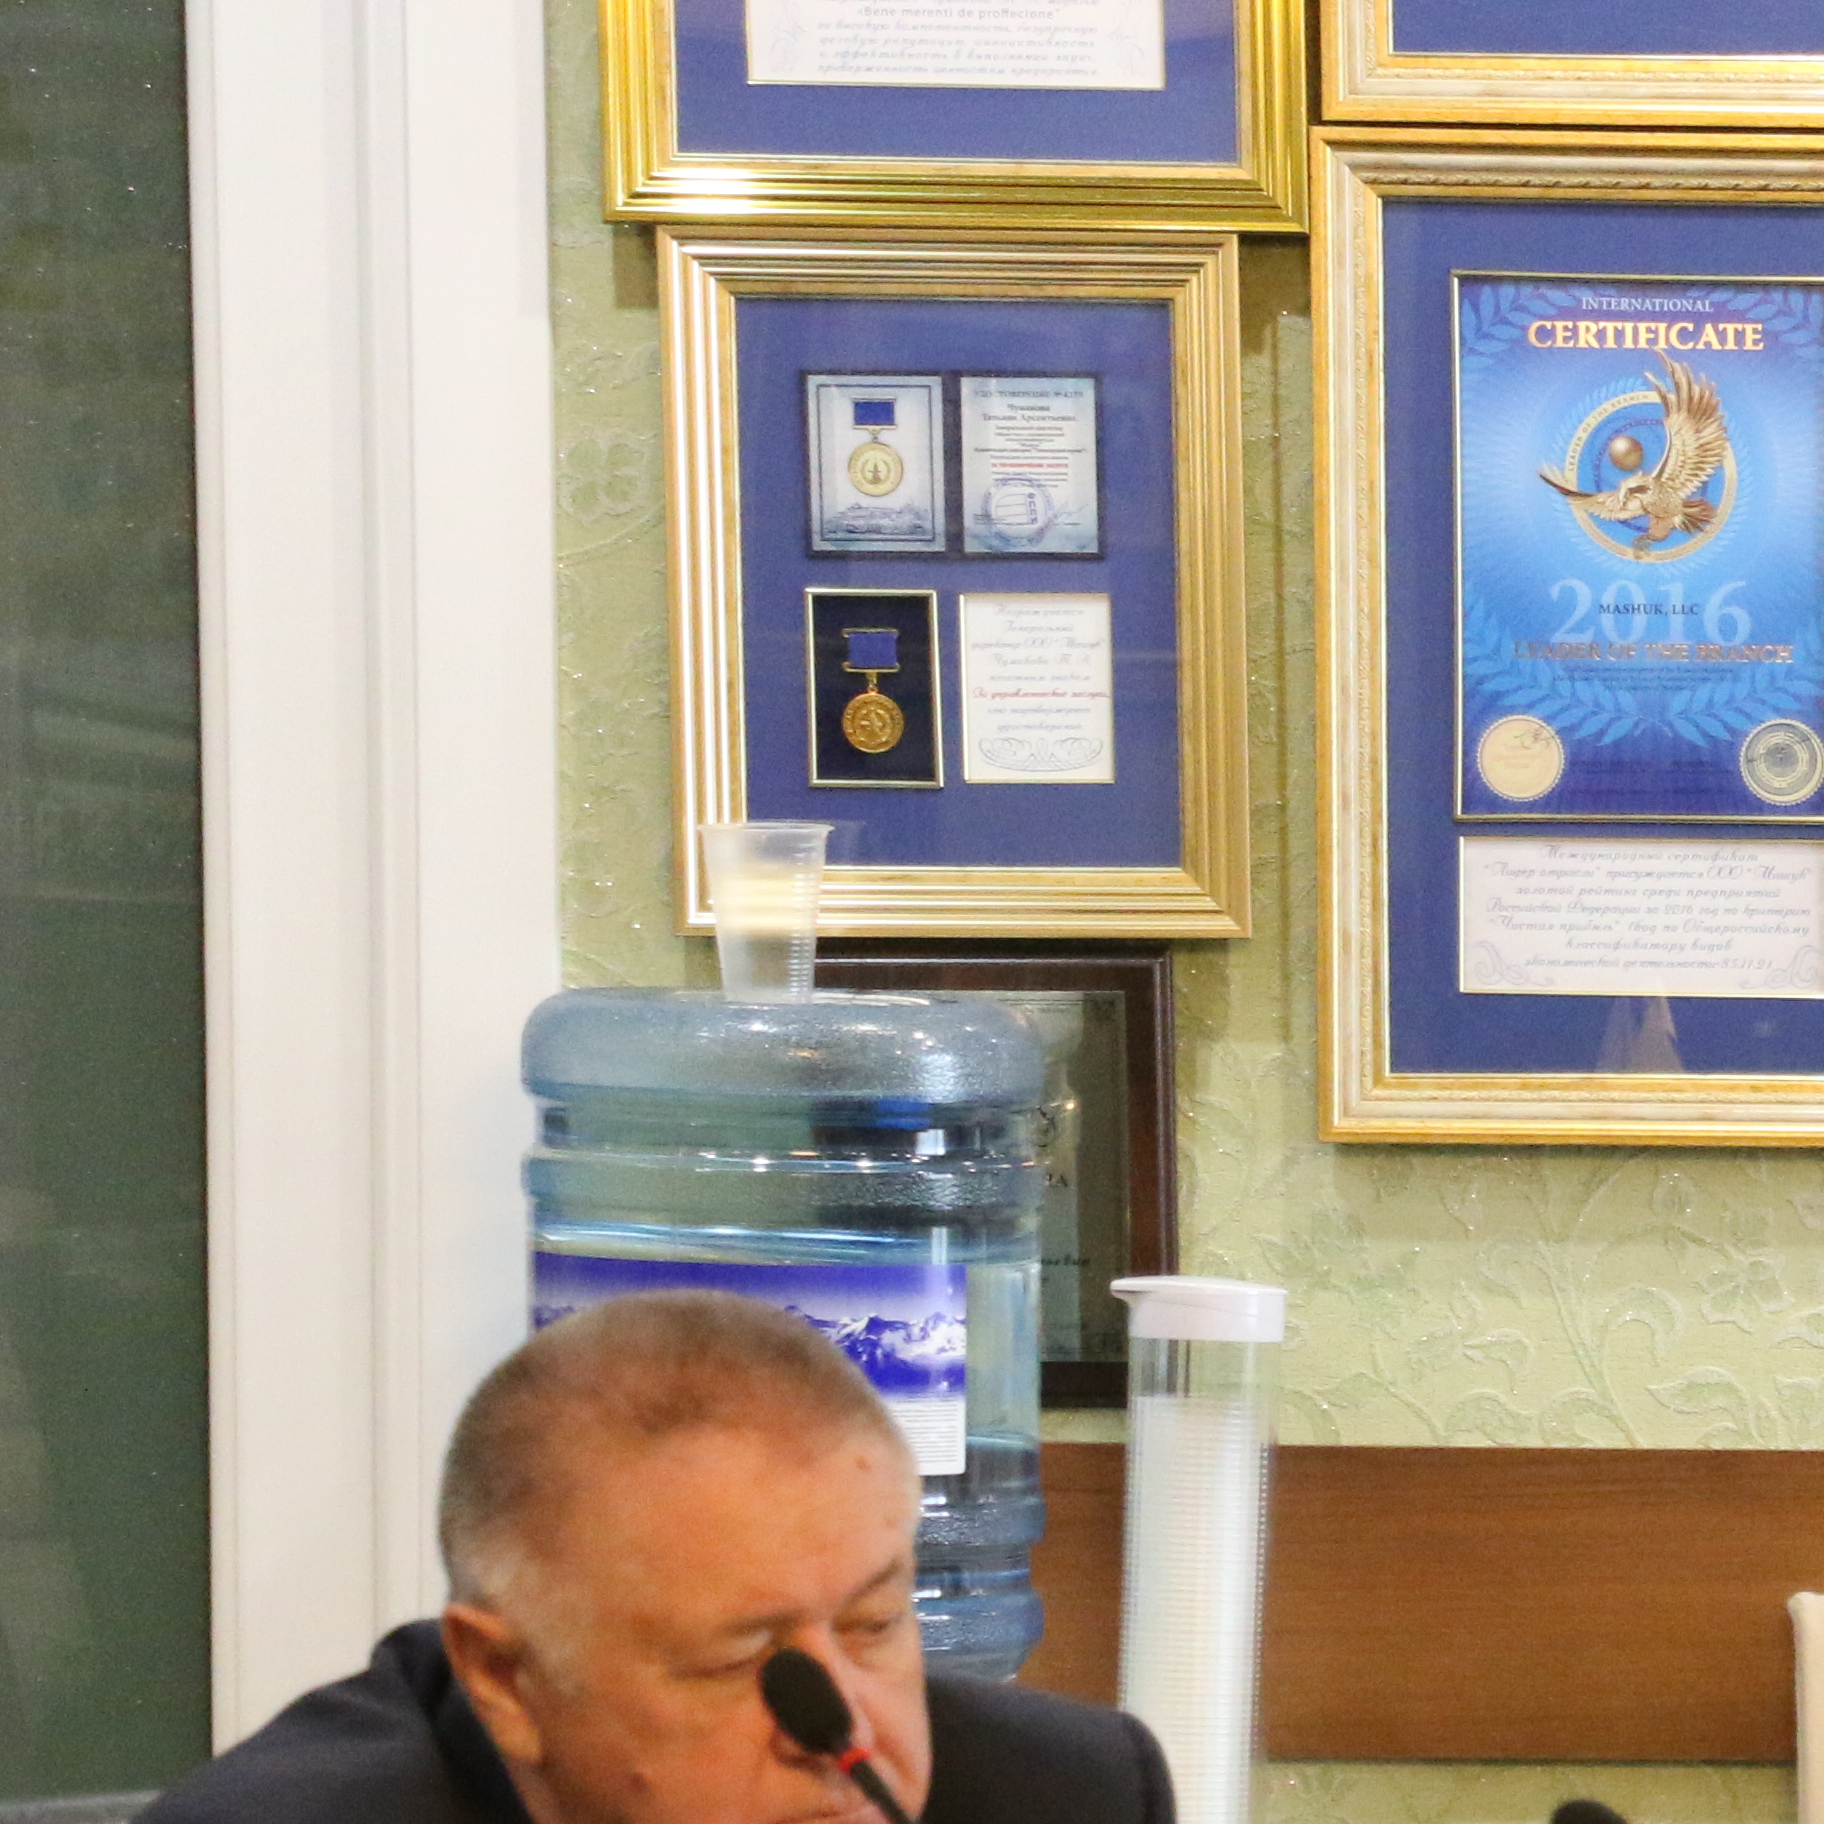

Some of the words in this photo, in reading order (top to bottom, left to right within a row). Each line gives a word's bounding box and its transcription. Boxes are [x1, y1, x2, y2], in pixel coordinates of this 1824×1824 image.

[901, 7, 953, 18] merenti
[957, 7, 974, 19] de
[1581, 296, 1714, 312] INTERNATIONAL
[1526, 319, 1766, 351] CERTIFICATE
[1548, 576, 1753, 646] 2016
[1598, 603, 1669, 617] MASHUK,
[1671, 603, 1700, 616] LLC
[1513, 641, 1601, 661] LEADER
[1608, 643, 1638, 662] OF
[1644, 643, 1691, 663] THE
[1696, 643, 1795, 664] BRANCH
[1667, 846, 1759, 865] сертификат
[1706, 865, 1744, 881] ООО
[1515, 886, 1575, 898] золотой
[1578, 886, 1638, 899] рейтинг
[1641, 888, 1682, 900] среди
[1686, 888, 1782, 902] предприятий
[1697, 906, 1720, 919] год
[1722, 907, 1738, 916] по
[1661, 923, 1678, 933] по
[1690, 936, 1735, 952] видов
